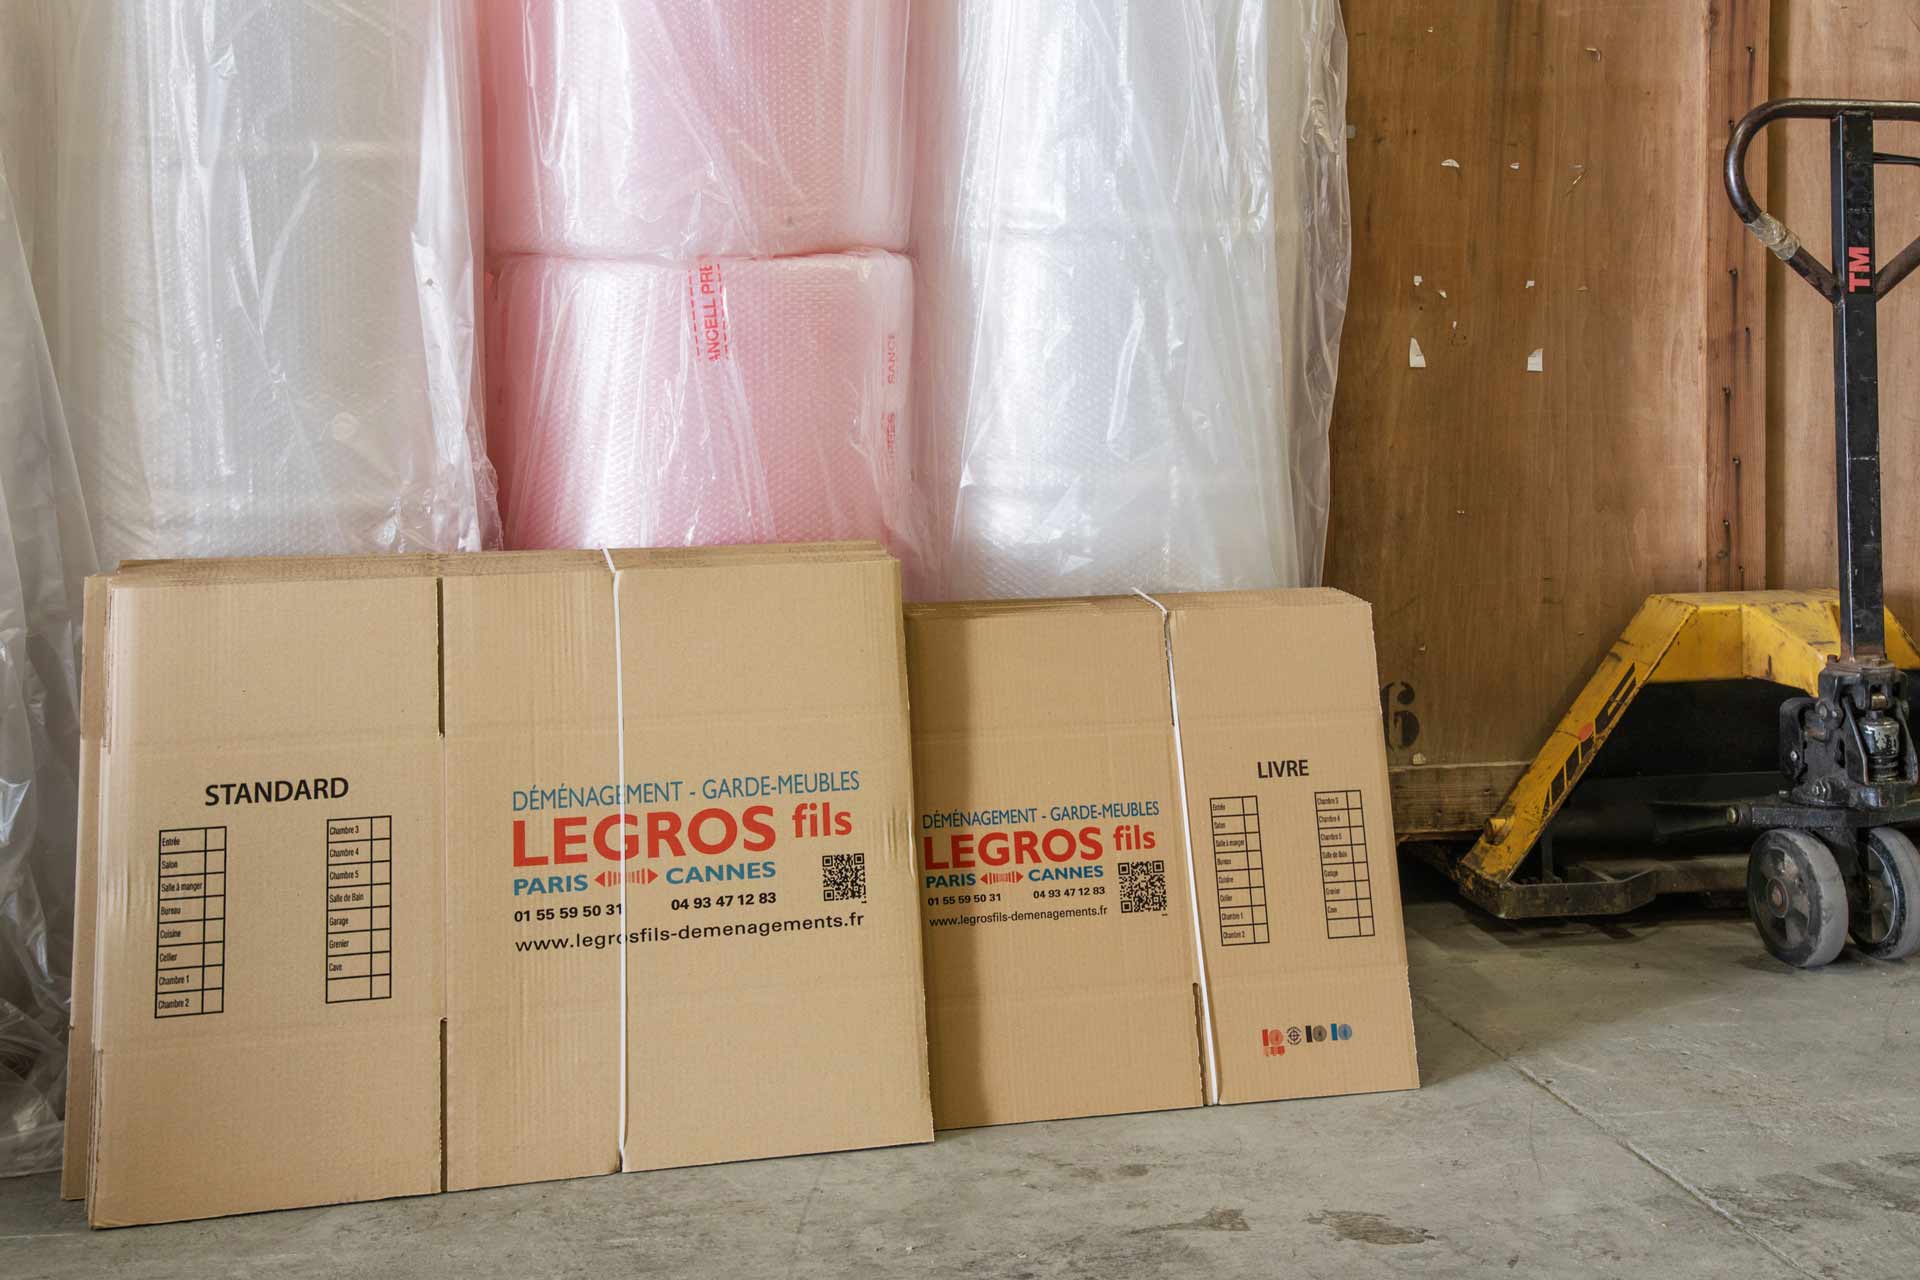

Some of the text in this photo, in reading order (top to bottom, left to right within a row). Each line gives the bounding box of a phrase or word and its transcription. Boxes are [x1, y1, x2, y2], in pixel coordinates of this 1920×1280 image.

[1848, 246, 1871, 293] TM
[1257, 759, 1310, 778] LIVRE
[205, 777, 349, 806] STANDARD
[512, 781, 683, 812] DÉMÉNAGEMENT
[702, 770, 860, 800] GARDE-MEUBLES
[922, 808, 1038, 829] DÉMÉNAGEMENT
[1050, 801, 1159, 821] GARDE-MEUBLES
[329, 825, 359, 835] Chambre 3
[513, 802, 853, 867] LEGROS fils
[329, 847, 359, 857] Chambre 4
[923, 824, 1156, 870] LEGROS fils
[329, 871, 354, 880] Chambre
[513, 861, 777, 896] PARIS CANNES
[926, 865, 1104, 889] PARIS CANNES
[514, 892, 777, 922] 01 55 59 50 31 04 93 47 12 83
[928, 886, 1105, 906] 01 55 59 50 31 04 93 47 12 83
[329, 917, 348, 926] Garage
[929, 905, 1108, 927] www.legrosfils-demenagements.fr
[515, 912, 865, 952] www.legrosfils-demenagements.fr
[329, 939, 349, 948] Grenier
[329, 963, 342, 971] Cave
[159, 976, 184, 985] Chambre
[158, 998, 189, 1009] Chambre 2
